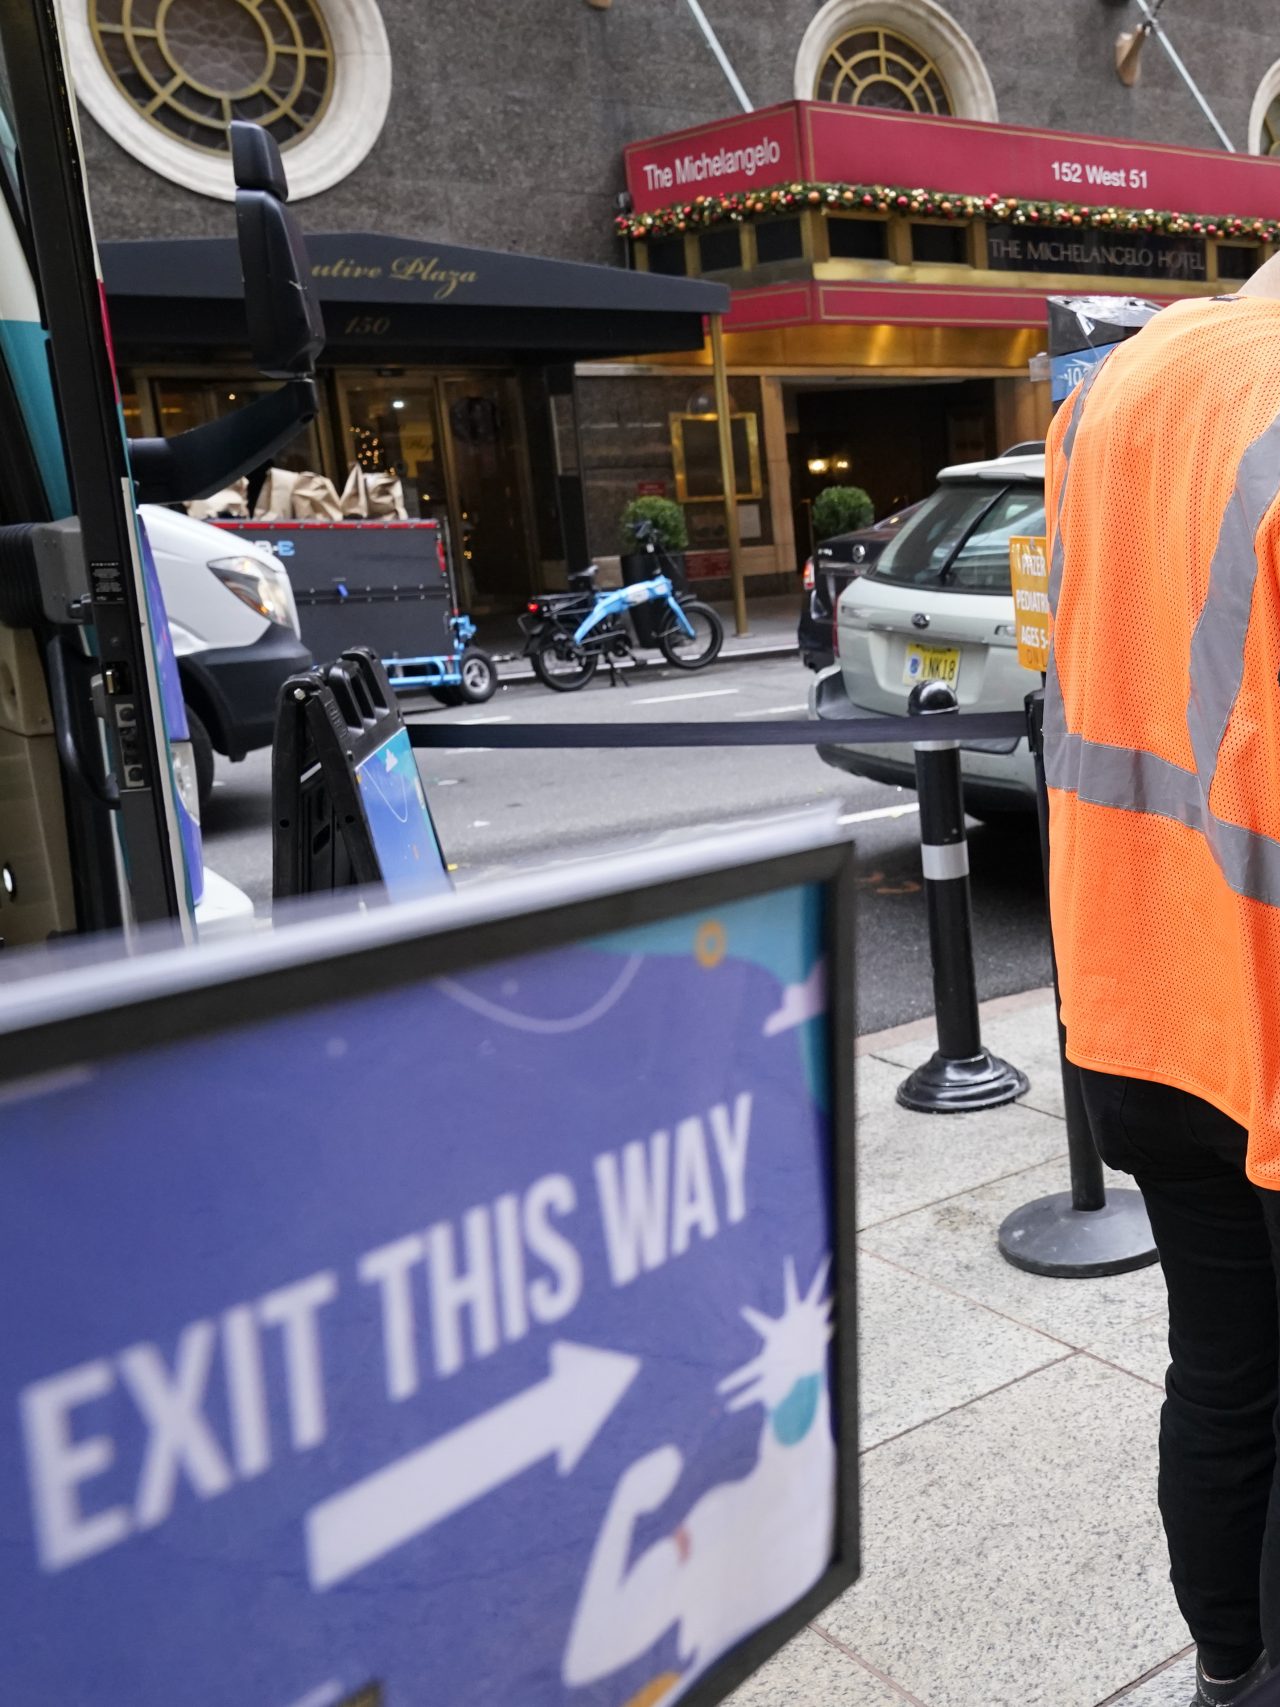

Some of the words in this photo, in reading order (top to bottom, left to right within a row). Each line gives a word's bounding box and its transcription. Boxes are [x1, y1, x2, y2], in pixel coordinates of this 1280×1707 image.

[642, 163, 674, 191] The
[674, 136, 781, 186] Michelangelo
[1051, 160, 1083, 184] 152
[1085, 163, 1127, 189] West
[1129, 168, 1148, 190] 51
[989, 238, 1023, 260] THE
[1026, 239, 1154, 268] MICHELANGELO
[1157, 249, 1206, 272] HOTEL
[311, 257, 382, 279] utive
[388, 256, 479, 300] Plaza
[343, 315, 392, 336] 150
[1021, 552, 1047, 577] PFIZER
[1021, 625, 1040, 648] AGES
[18, 1268, 340, 1576] EXIT
[356, 1172, 585, 1404] THIS
[592, 1090, 754, 1289] WAY
